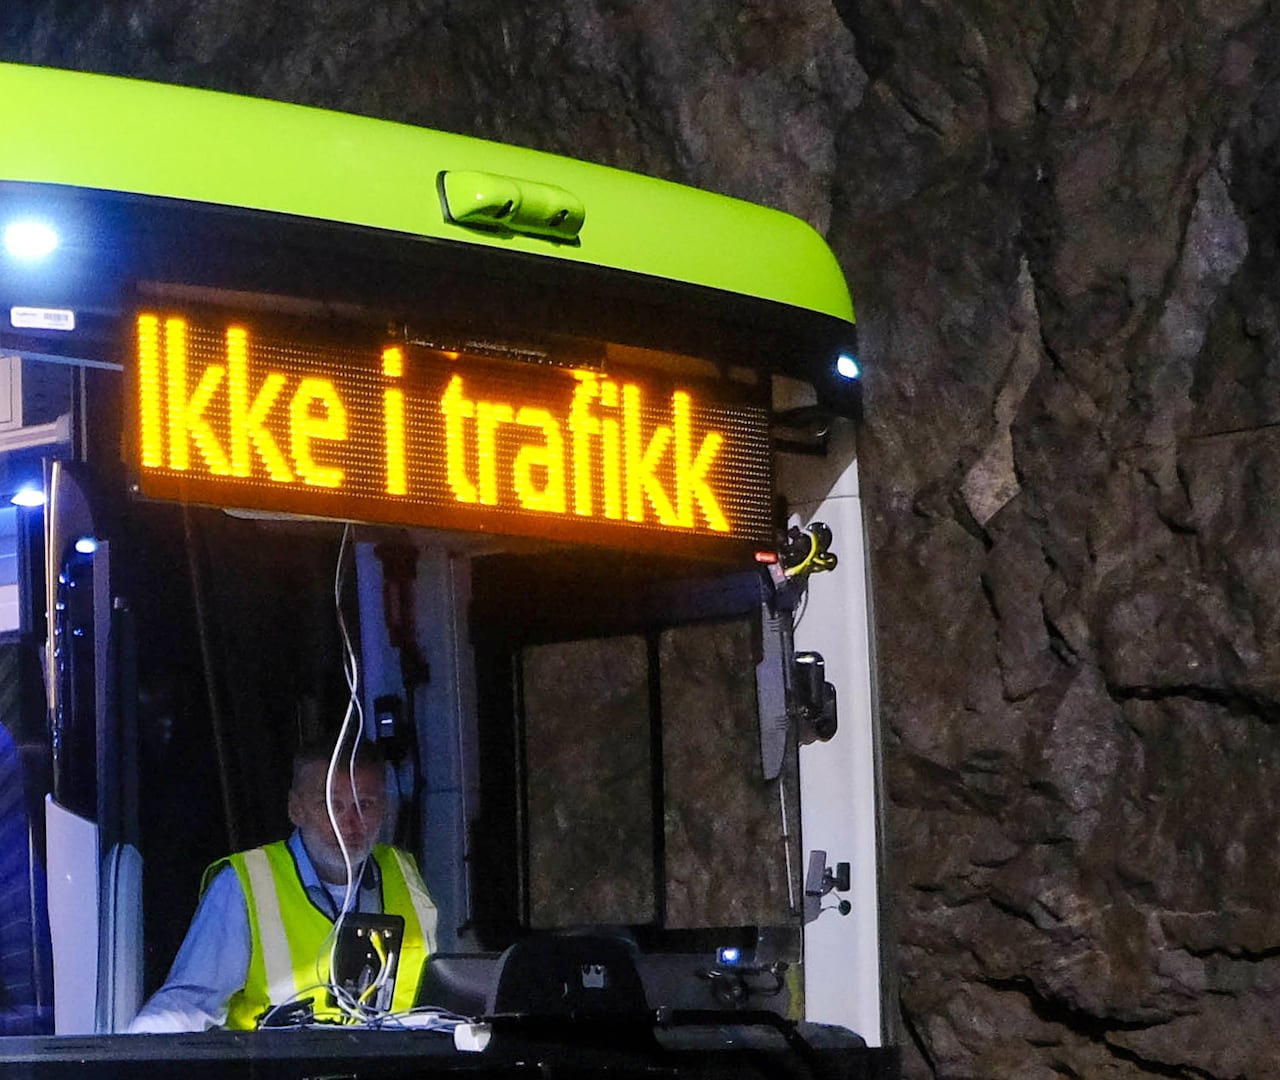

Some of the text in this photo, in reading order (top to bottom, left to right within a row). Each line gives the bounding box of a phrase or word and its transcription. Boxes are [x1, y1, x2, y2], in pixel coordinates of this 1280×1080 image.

[139, 314, 730, 532] Ikke i trafikk
